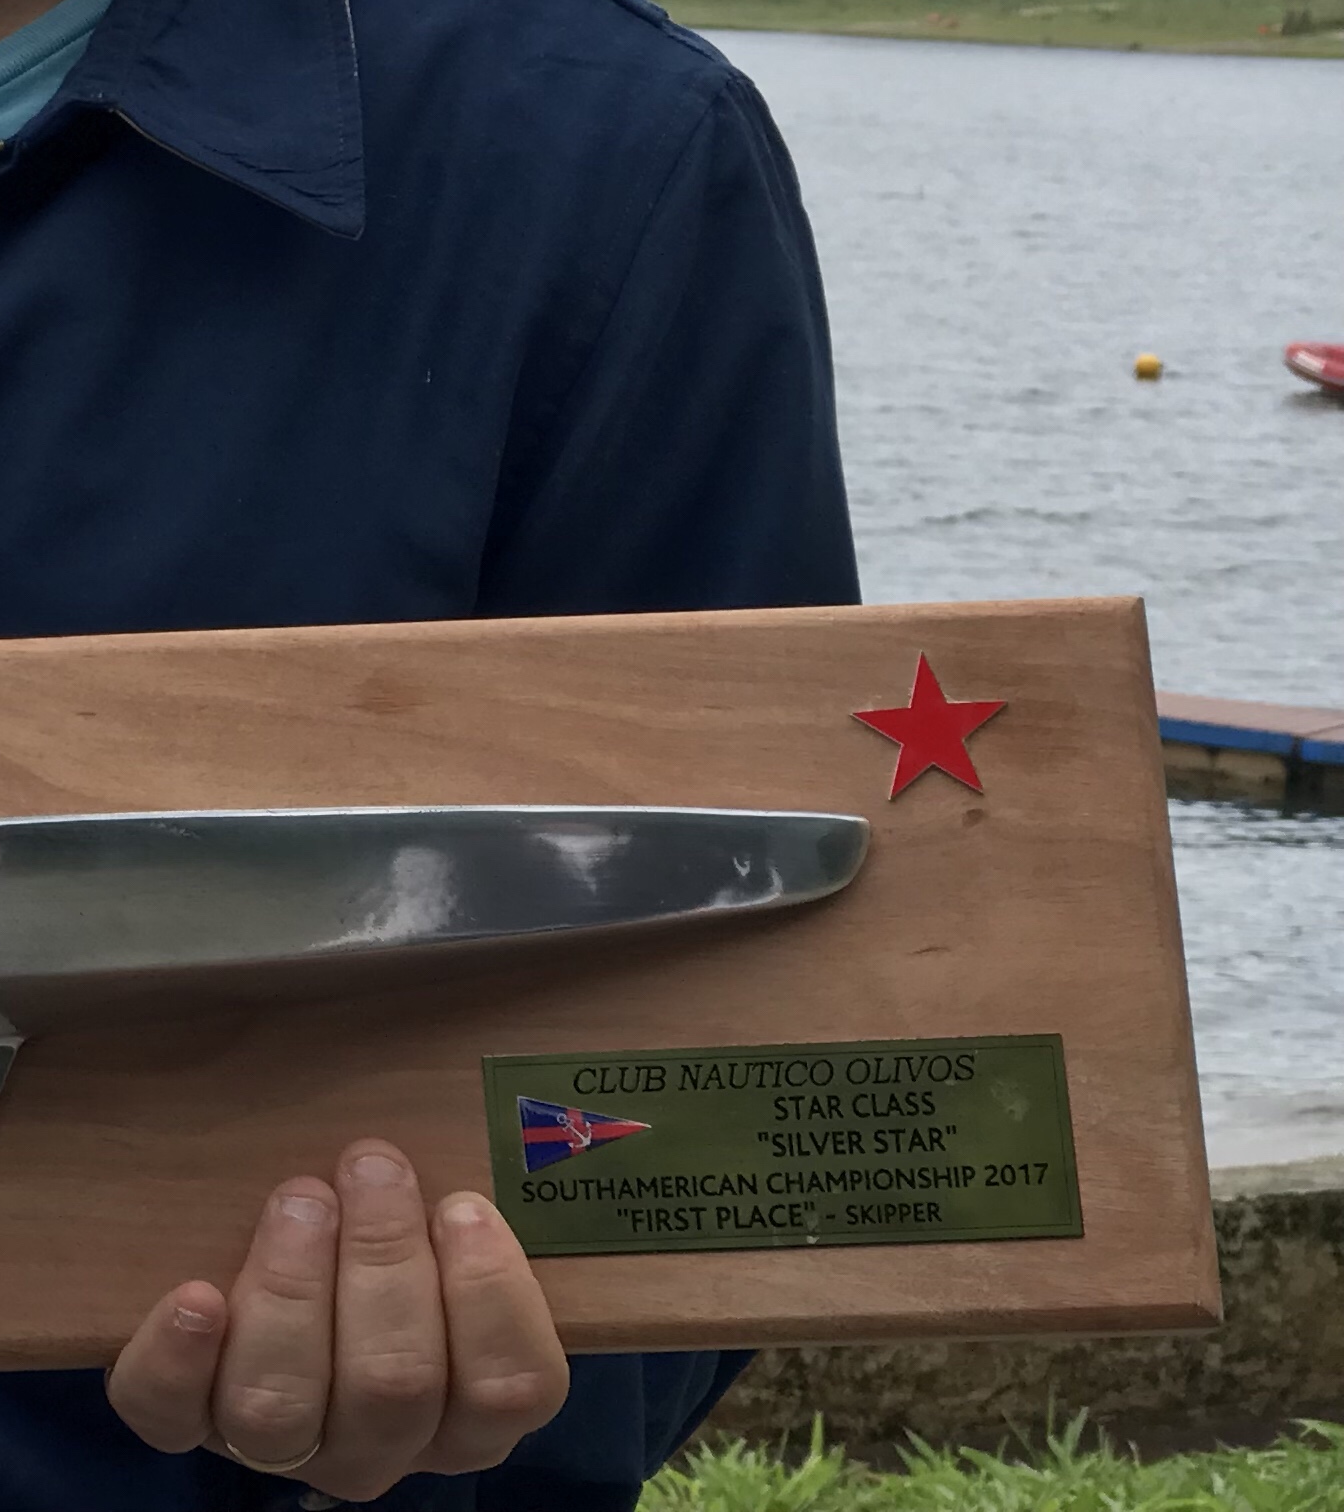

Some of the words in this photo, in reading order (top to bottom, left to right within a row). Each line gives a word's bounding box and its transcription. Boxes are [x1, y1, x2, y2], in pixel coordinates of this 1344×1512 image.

[573, 1067, 666, 1095] CLUB
[680, 1059, 834, 1090] NAUTICO
[846, 1054, 975, 1084] OLIVOS
[773, 1094, 843, 1121] STAR
[852, 1091, 936, 1118] CLASS
[758, 1131, 865, 1157] "SILVER
[873, 1125, 957, 1154] STAR"
[521, 1173, 758, 1203] SOUTHAMERICAN
[766, 1167, 976, 1194] CHAMPIONSHIP
[984, 1163, 1048, 1186] 2017
[617, 1207, 707, 1233] "FIRST
[716, 1202, 814, 1229] PLACE"
[845, 1202, 942, 1226] SKIPPER
